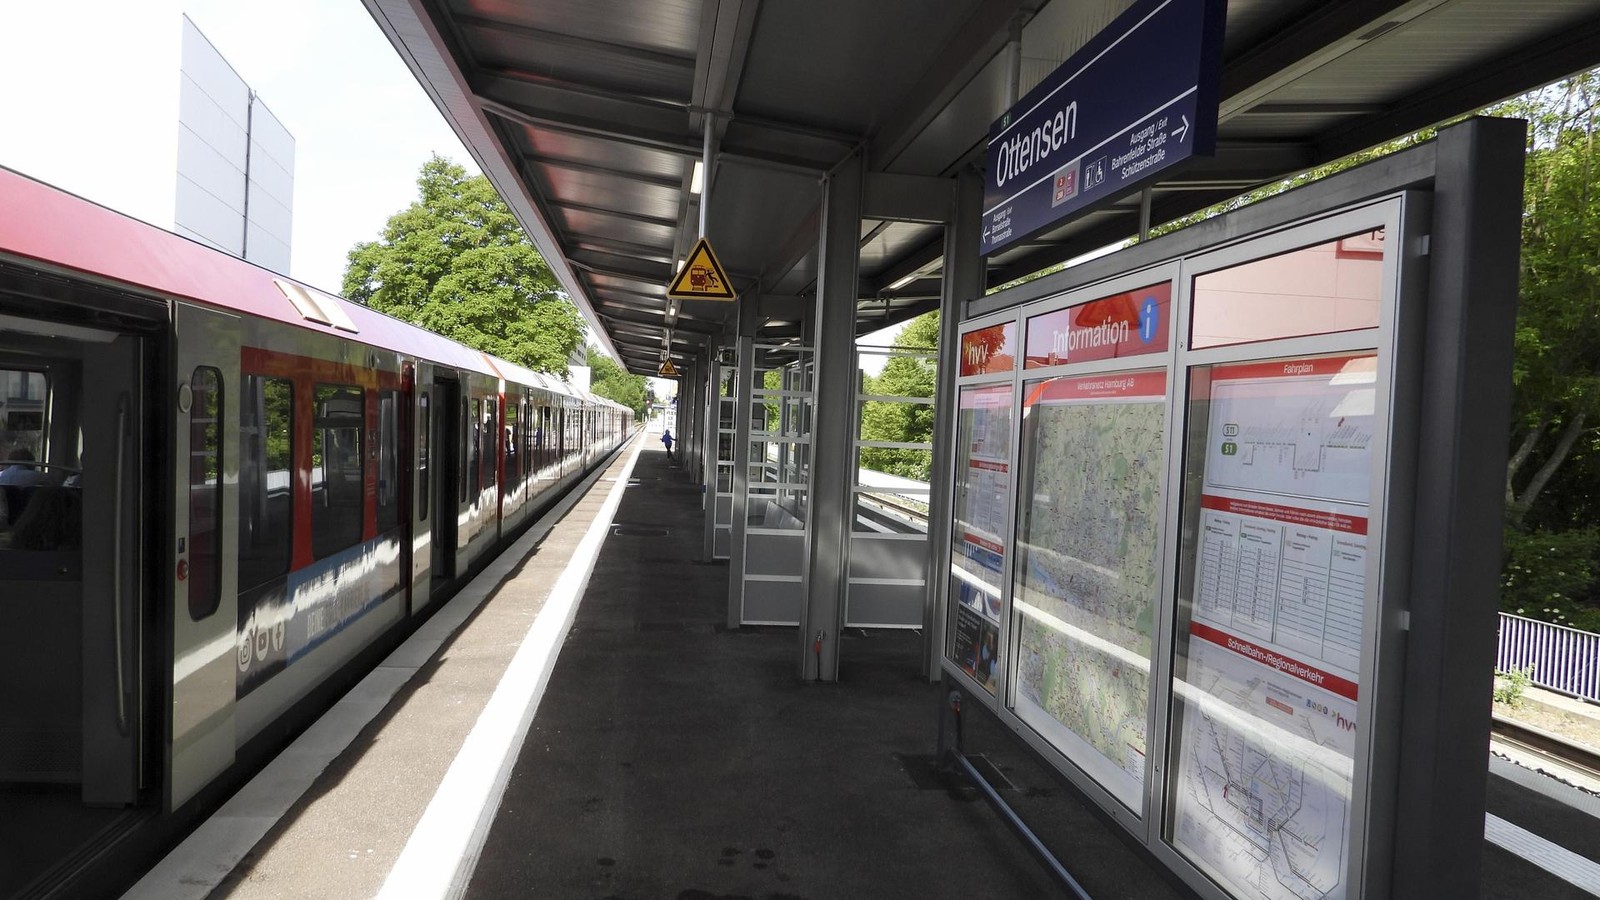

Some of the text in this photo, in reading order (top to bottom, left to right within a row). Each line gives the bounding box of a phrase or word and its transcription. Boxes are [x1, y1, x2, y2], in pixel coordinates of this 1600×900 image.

[996, 100, 1078, 188] Ottensen
[1129, 124, 1155, 147] Ausgang
[1158, 116, 1168, 130] Exit
[1111, 132, 1167, 171] Bahrenfelder Straße
[1121, 149, 1166, 180] Schützenstraße
[1052, 315, 1129, 354] Information
[1283, 363, 1314, 376] Fahrplan
[1224, 443, 1234, 454] S1
